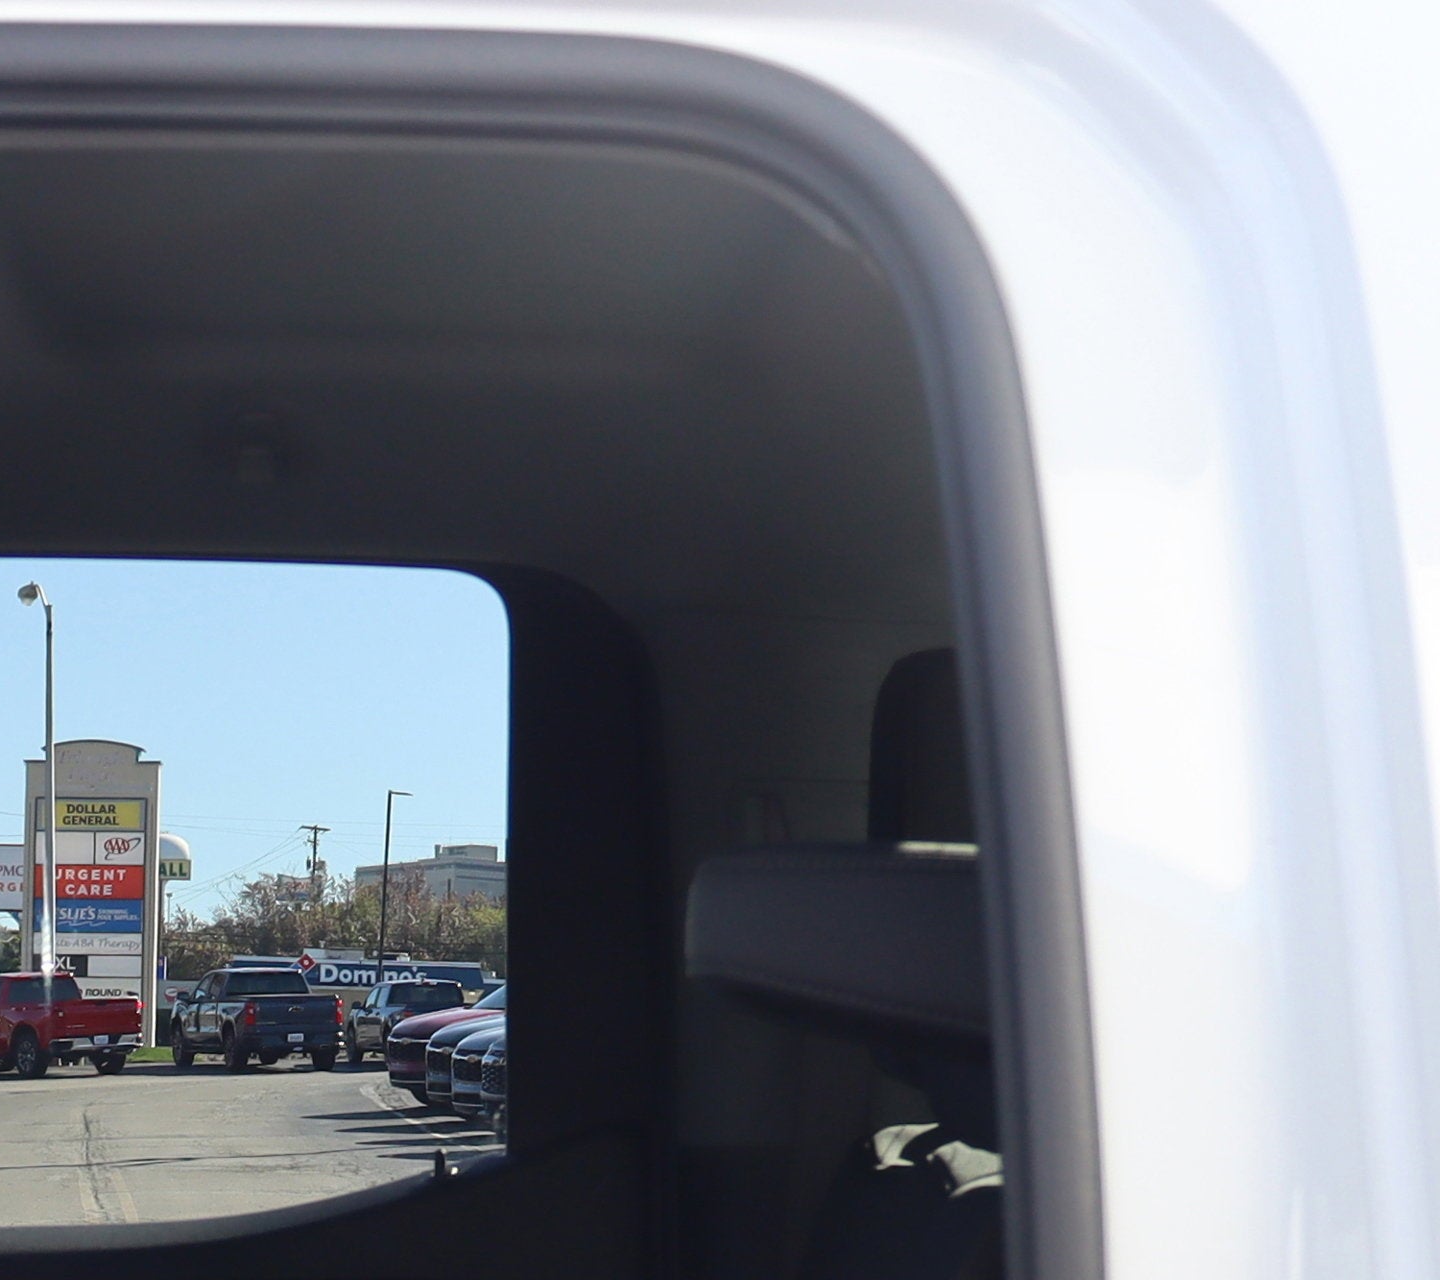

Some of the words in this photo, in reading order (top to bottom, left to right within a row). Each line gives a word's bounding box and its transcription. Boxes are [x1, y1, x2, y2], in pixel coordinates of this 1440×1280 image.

[66, 803, 116, 814] DOLLAR
[62, 815, 119, 825] GENERAL
[159, 862, 187, 876] ALL
[65, 884, 113, 896] CARE
[59, 905, 96, 920] SLIE'S
[320, 964, 427, 984] Domno's
